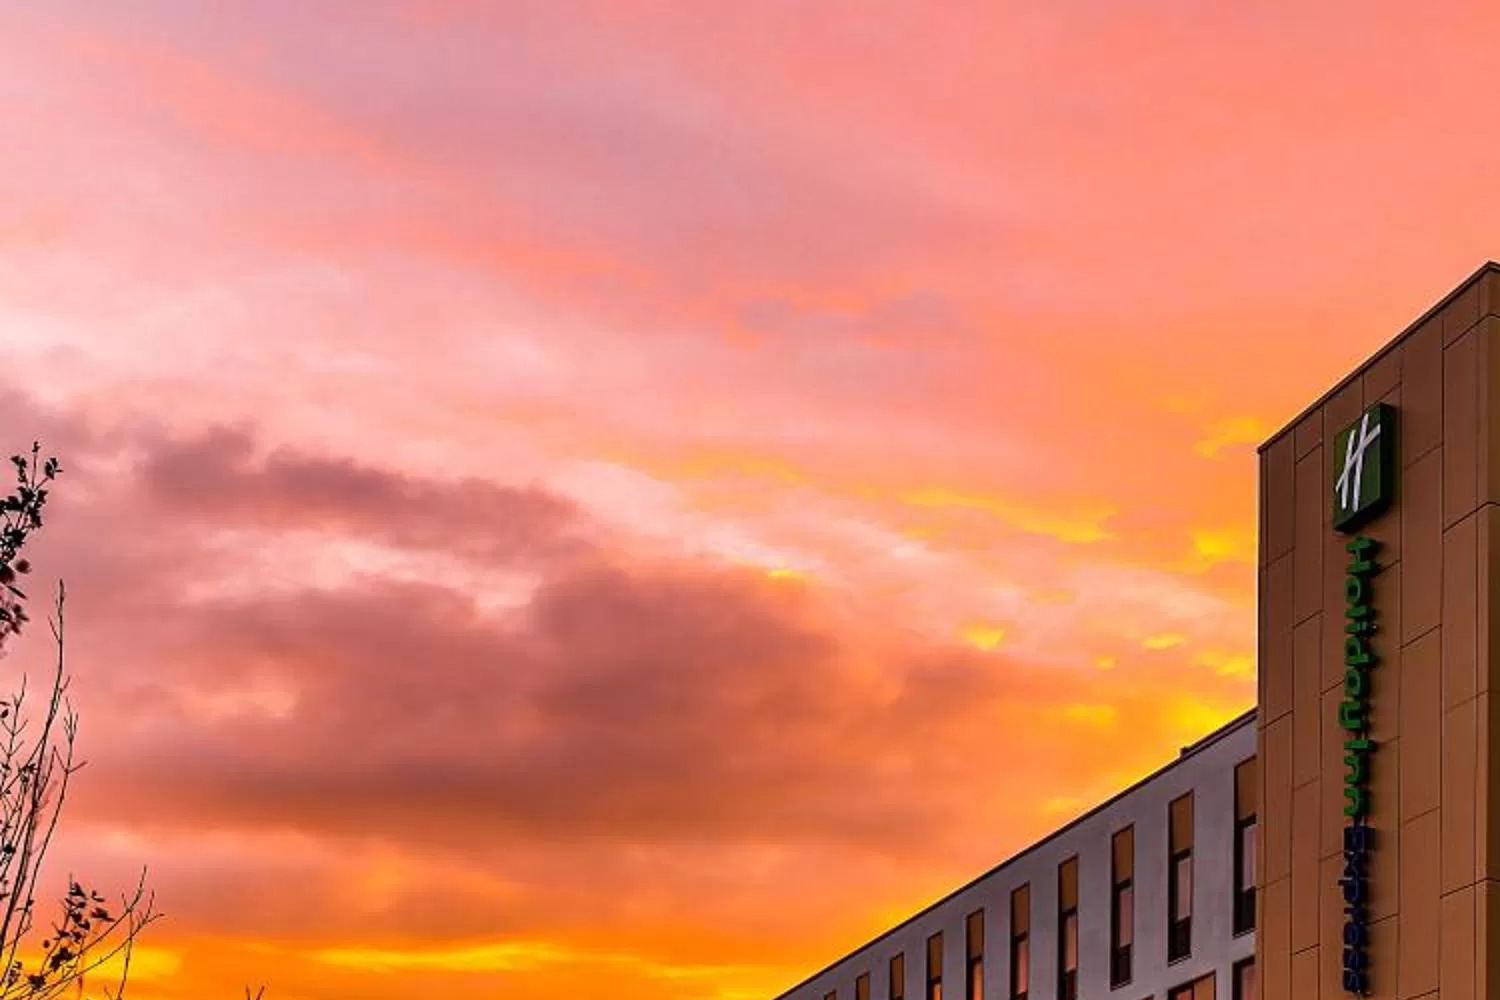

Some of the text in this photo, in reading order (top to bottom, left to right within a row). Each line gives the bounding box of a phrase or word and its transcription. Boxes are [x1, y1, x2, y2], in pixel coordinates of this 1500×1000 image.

[1338, 535, 1375, 992] Holiday Inn Express
